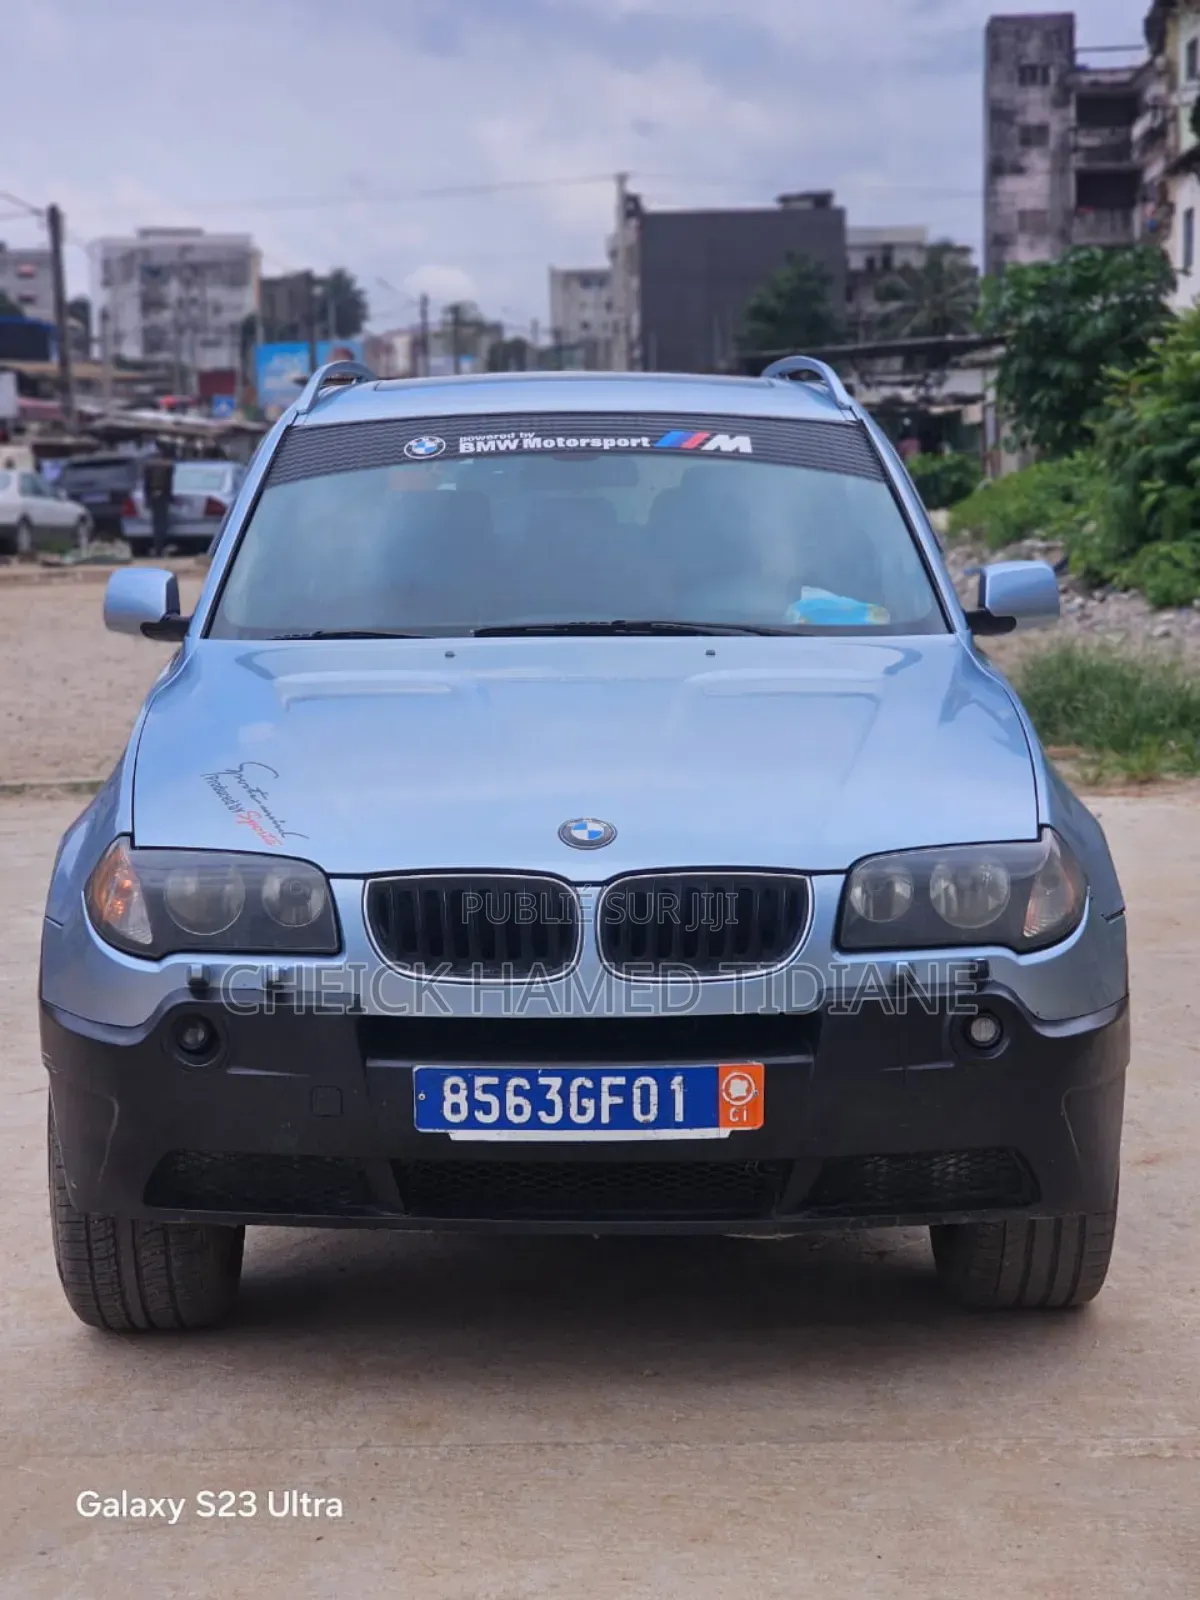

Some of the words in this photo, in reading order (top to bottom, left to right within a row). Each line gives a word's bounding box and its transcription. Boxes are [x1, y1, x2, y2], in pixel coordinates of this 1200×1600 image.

[459, 432, 515, 443] powered
[459, 439, 519, 453] BMW
[522, 436, 650, 449] Motorsport
